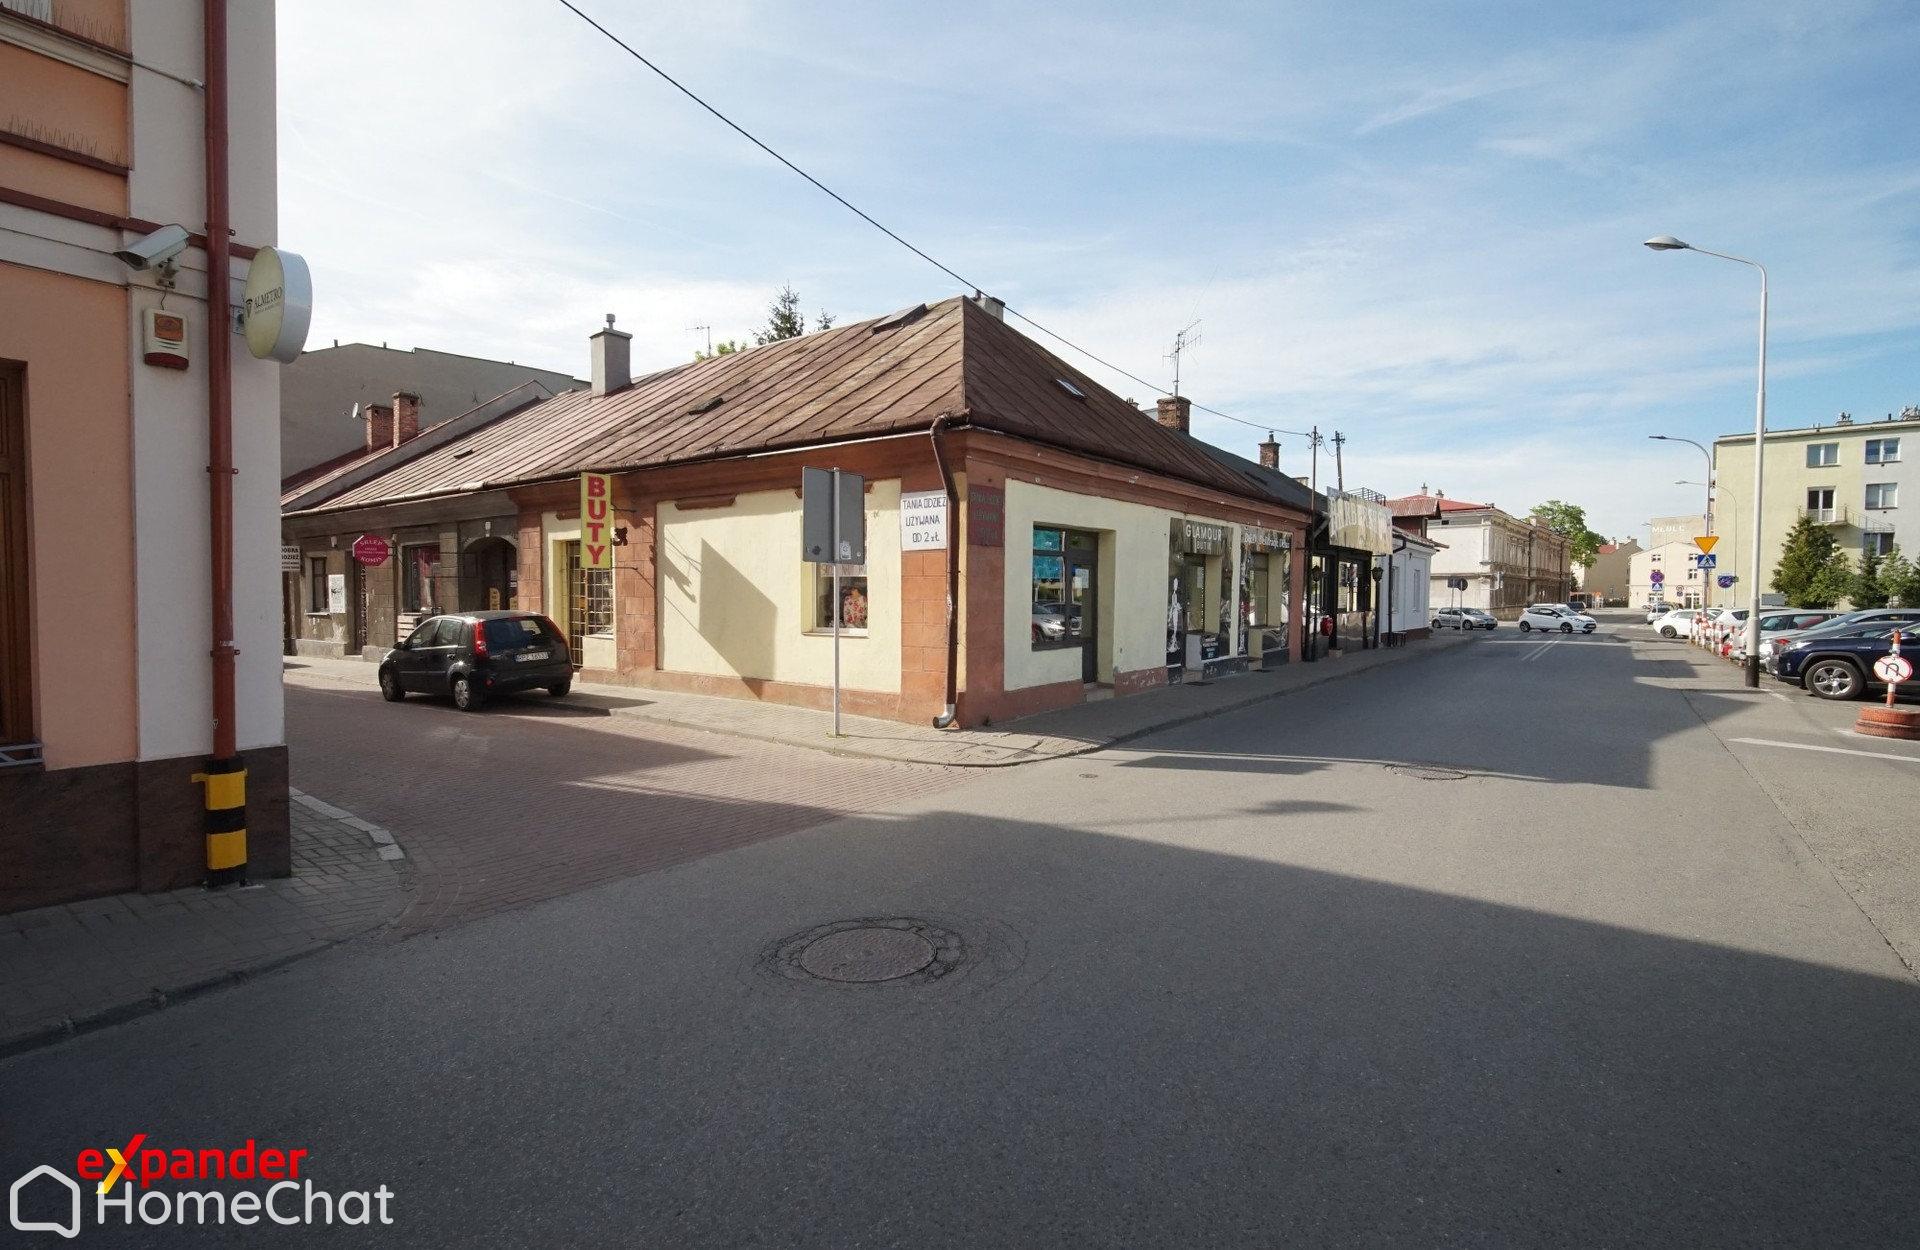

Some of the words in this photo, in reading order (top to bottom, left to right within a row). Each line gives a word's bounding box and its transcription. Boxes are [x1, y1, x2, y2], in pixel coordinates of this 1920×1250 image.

[903, 499, 923, 509] TANIA
[586, 475, 606, 565] BUTY
[912, 532, 922, 543] OD
[924, 531, 930, 542] 2
[1185, 524, 1222, 541] GLAMOUR
